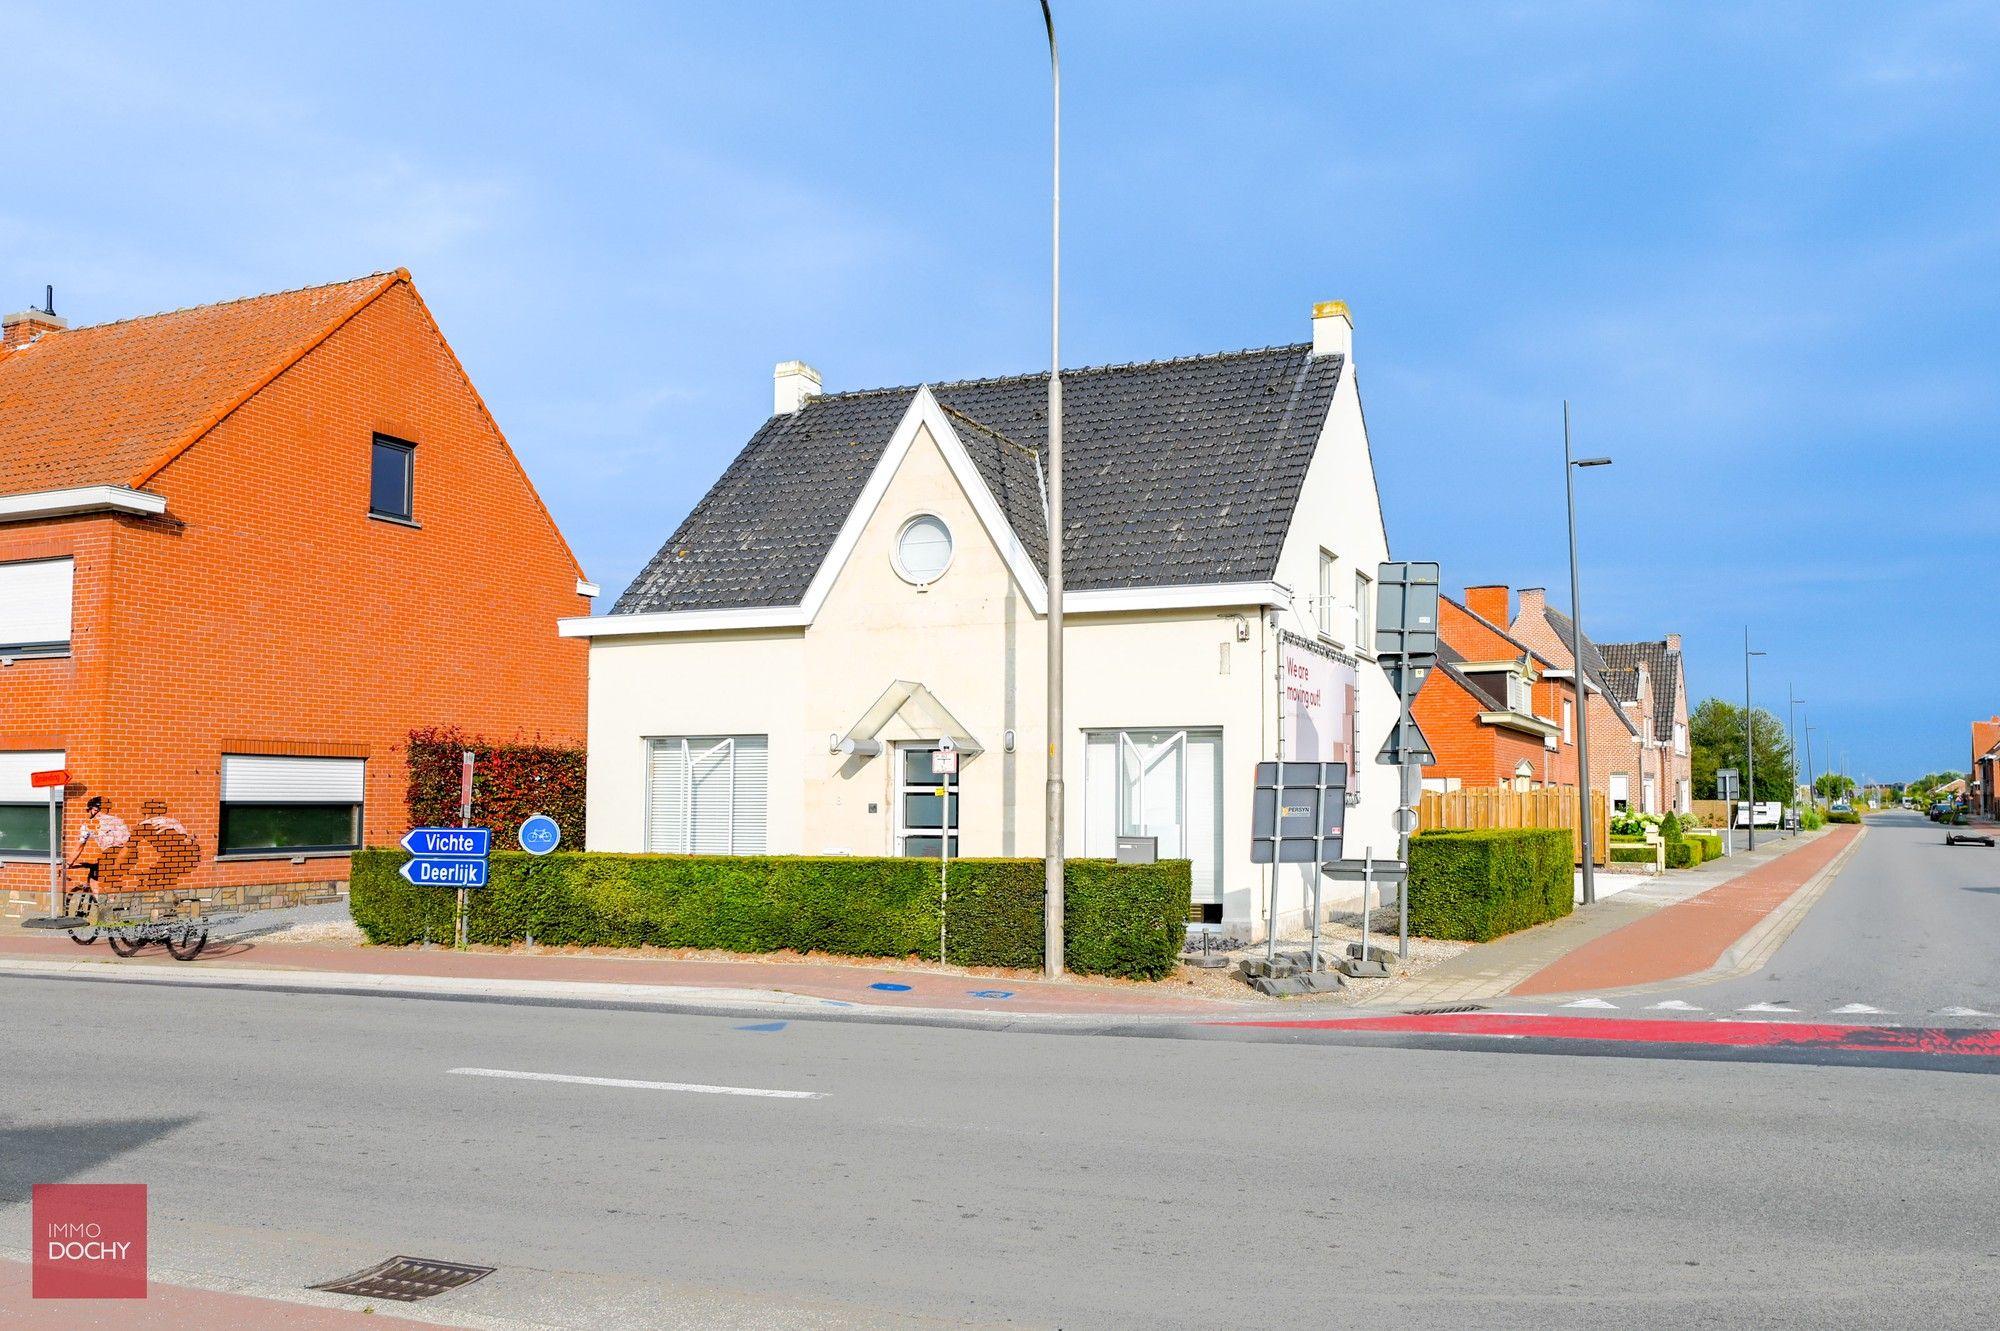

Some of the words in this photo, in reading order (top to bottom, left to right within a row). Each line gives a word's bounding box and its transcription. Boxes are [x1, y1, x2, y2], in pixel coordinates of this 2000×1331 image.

[1287, 656, 1297, 677] We
[1298, 665, 1308, 681] are
[1287, 684, 1309, 709] moving
[1310, 689, 1320, 708] out!
[425, 833, 474, 851] Vichte
[421, 862, 478, 885] Deerlijk
